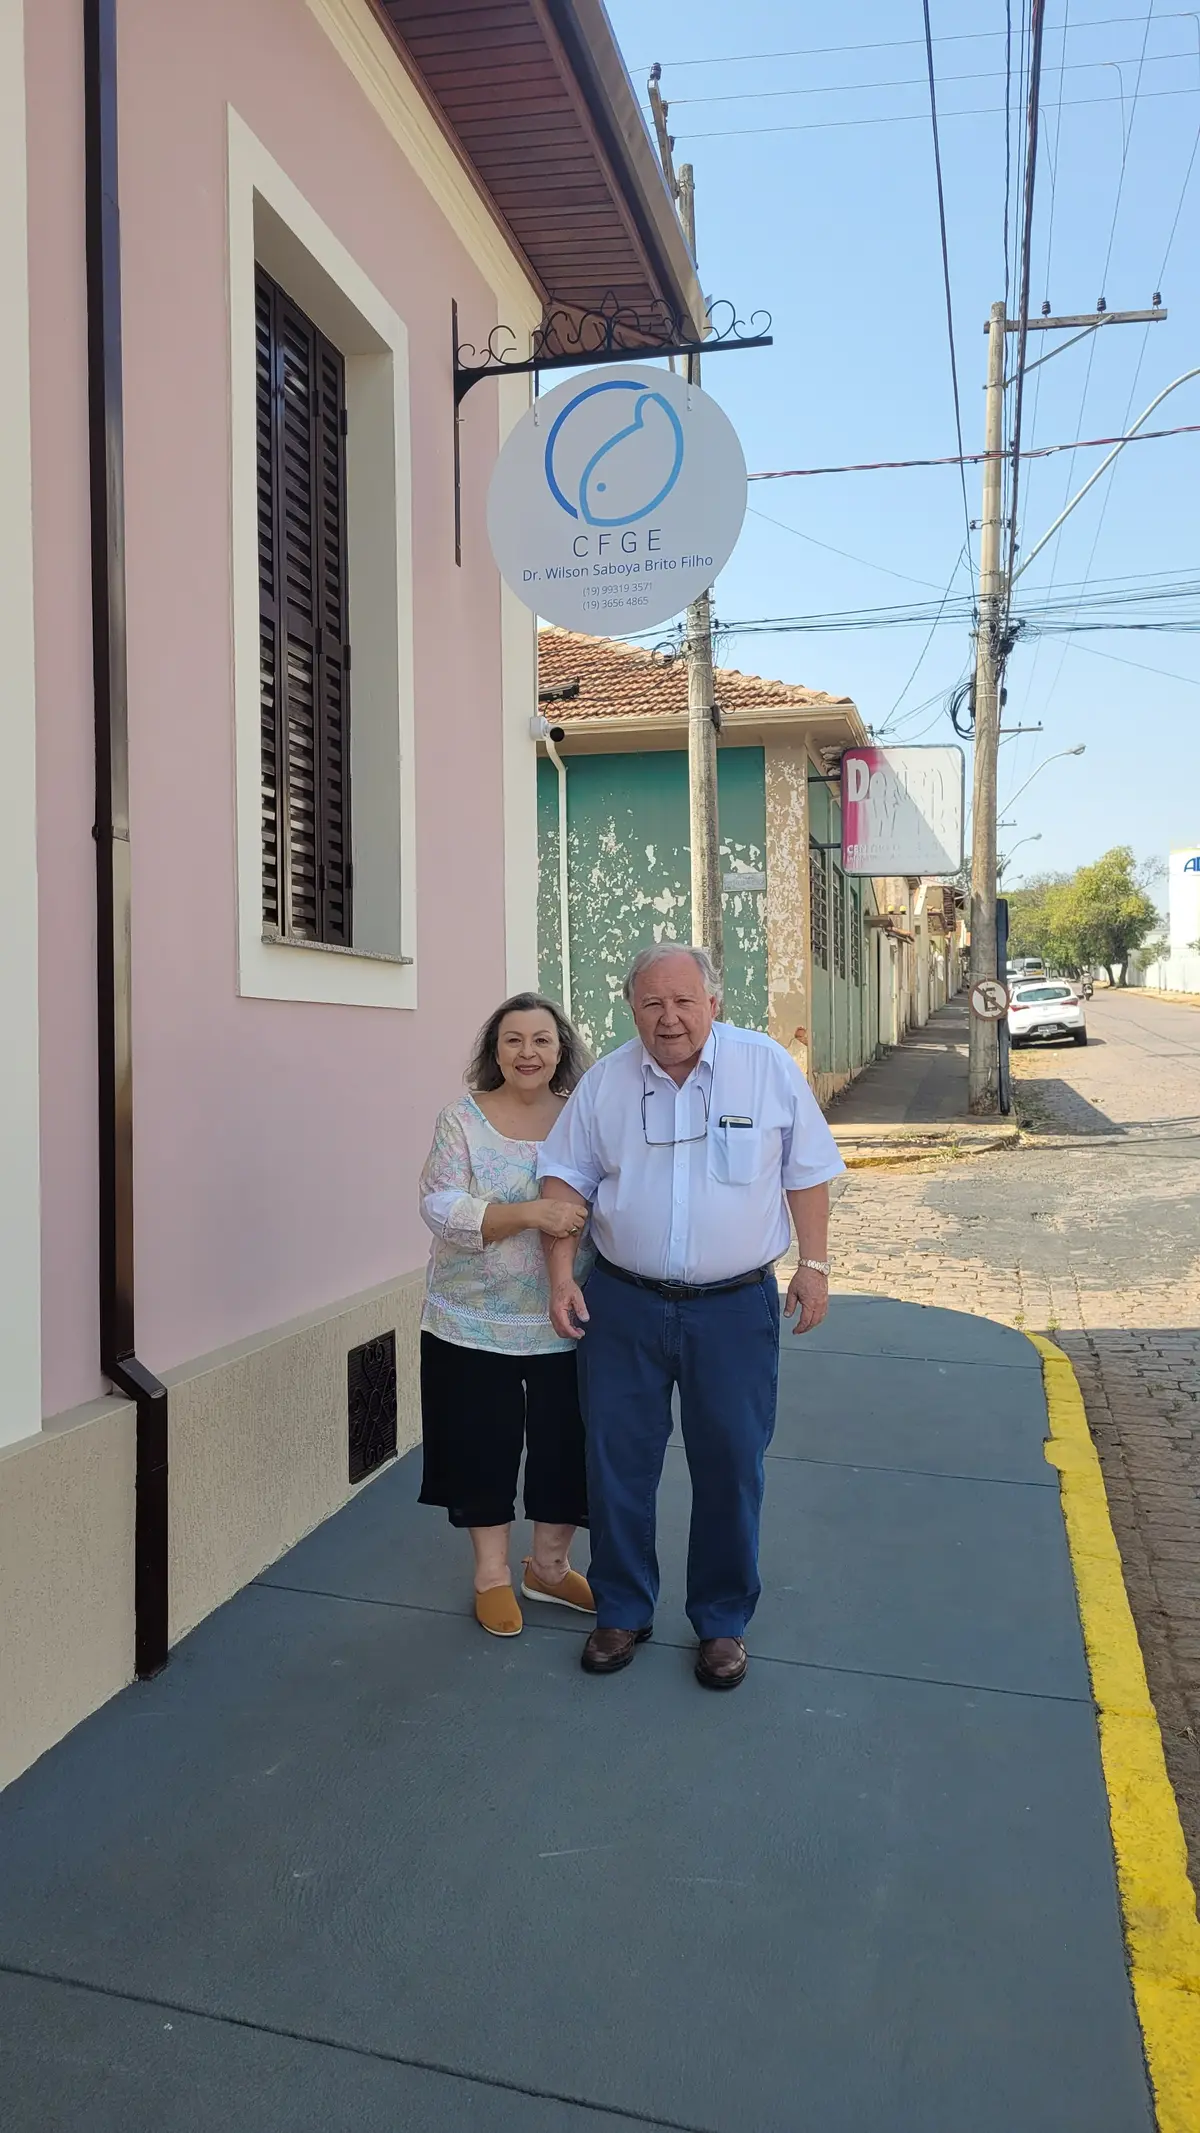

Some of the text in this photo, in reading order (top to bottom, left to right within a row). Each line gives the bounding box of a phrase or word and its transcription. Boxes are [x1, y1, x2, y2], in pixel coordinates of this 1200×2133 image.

[523, 555, 713, 581] Dr. Wilson Saboya Brito Filho
[582, 582, 653, 597] (19) 99319 3571
[582, 597, 649, 611] (19) 3656 4865
